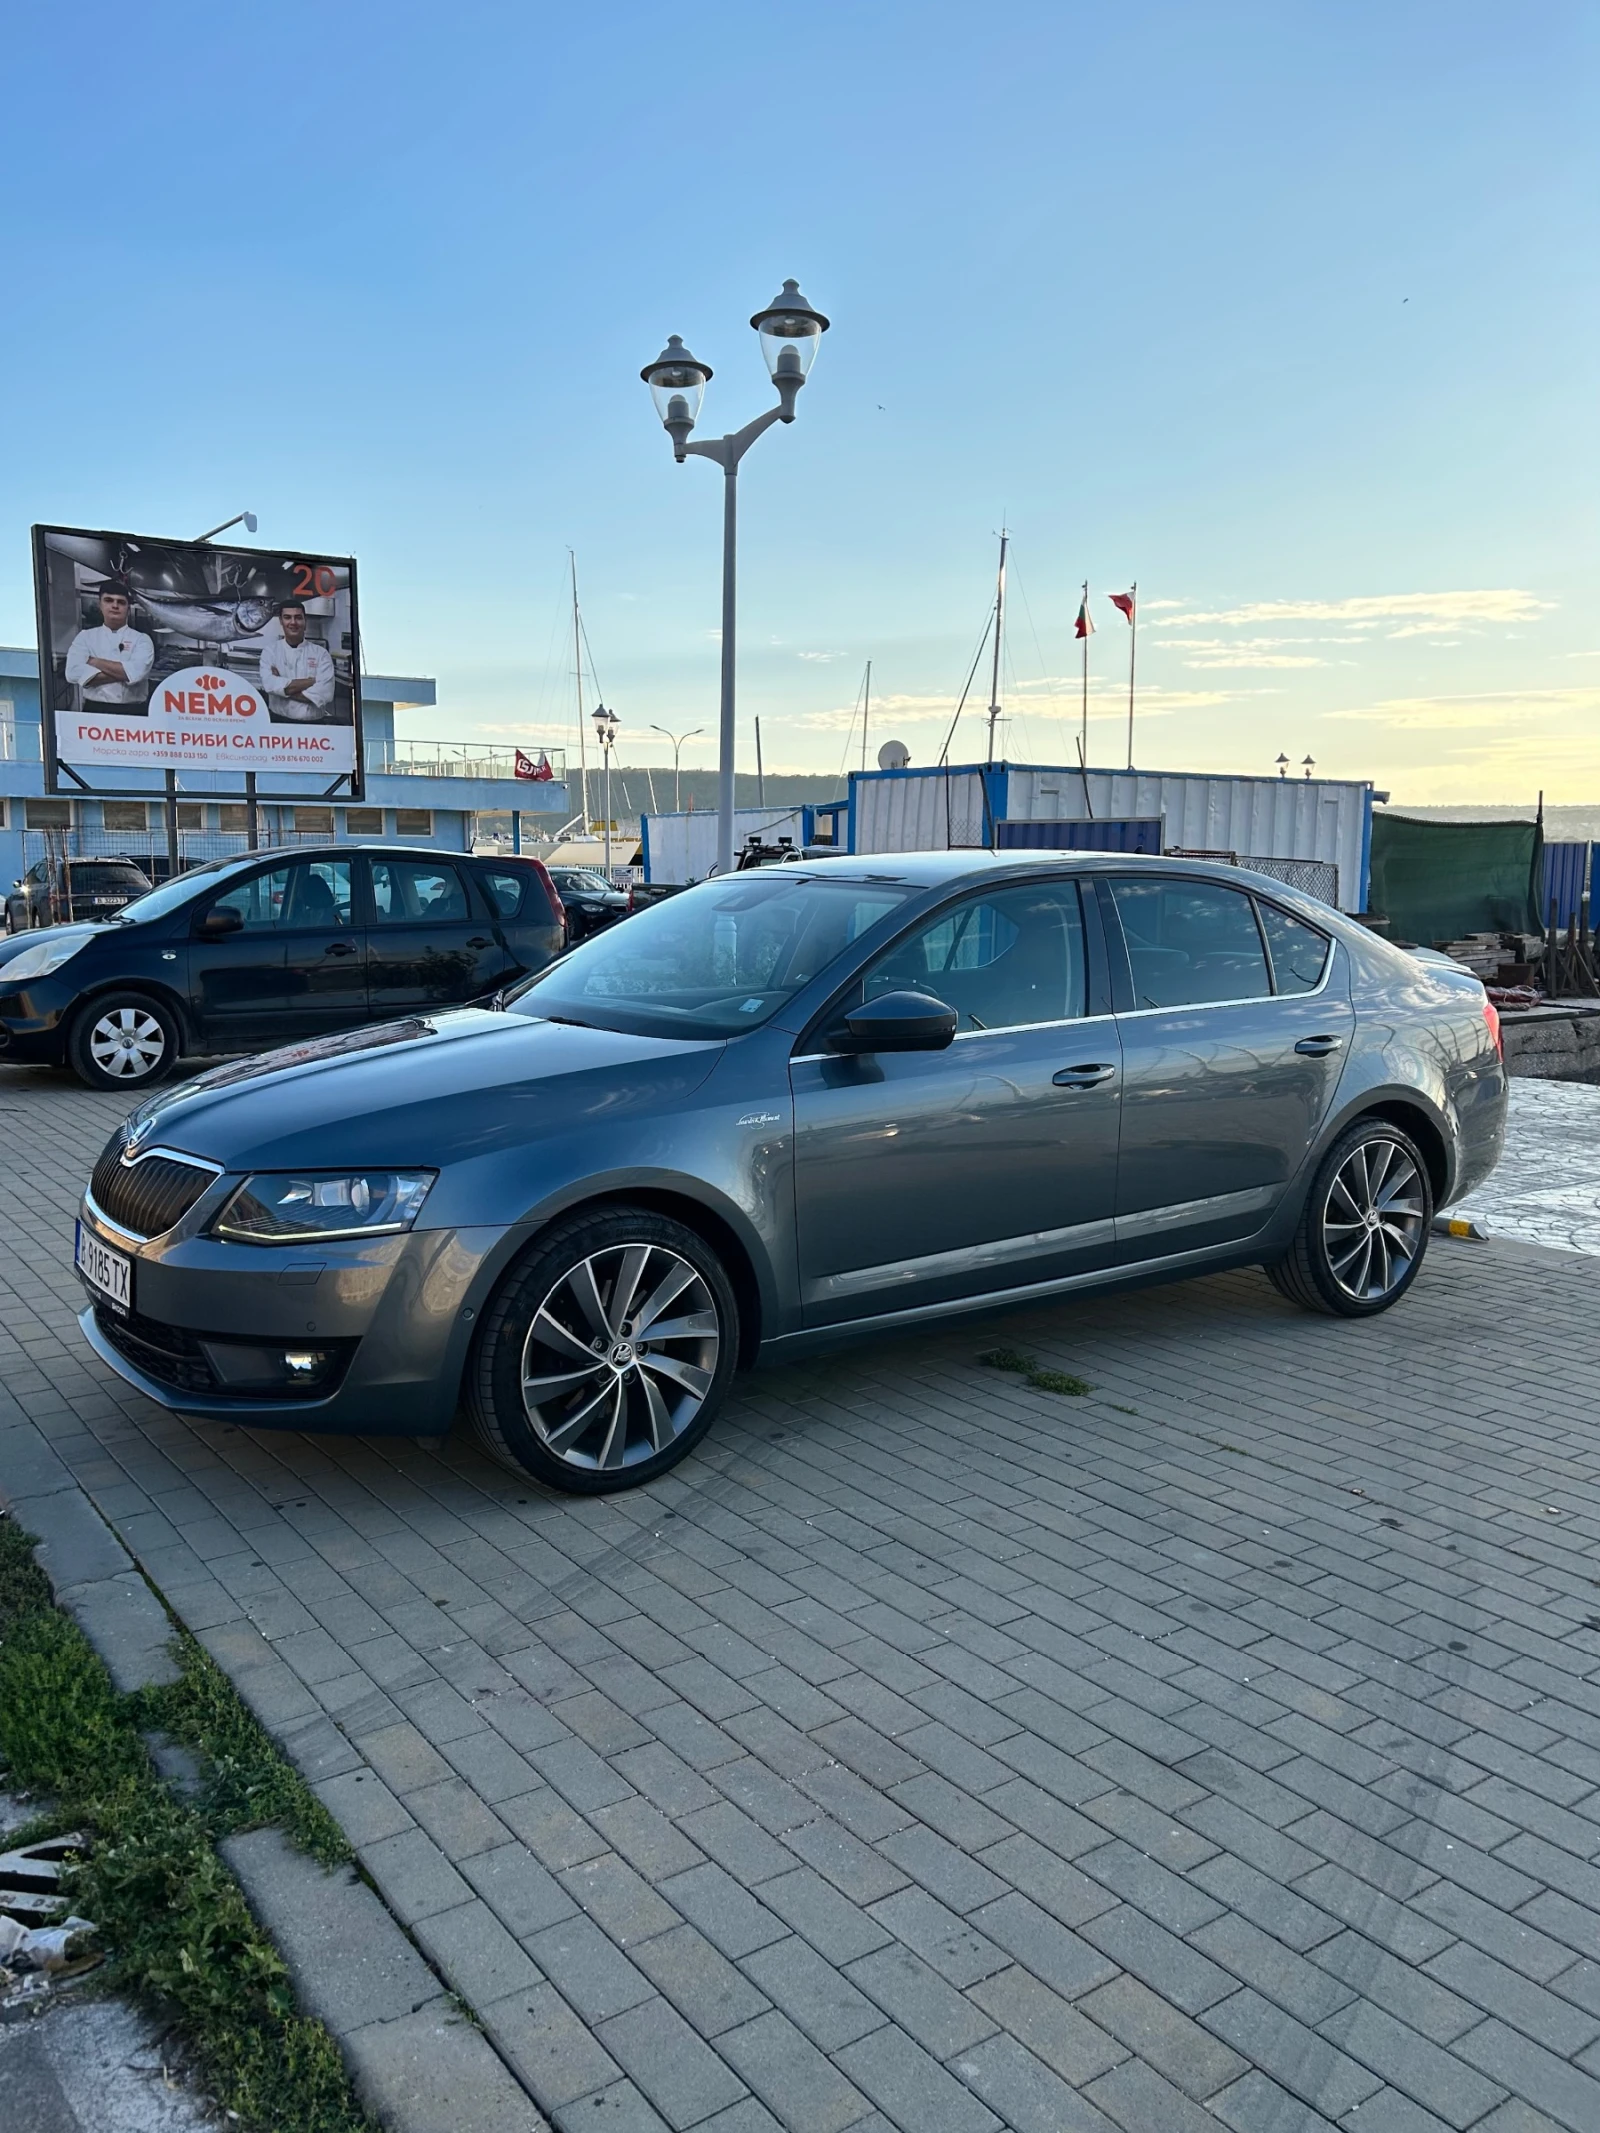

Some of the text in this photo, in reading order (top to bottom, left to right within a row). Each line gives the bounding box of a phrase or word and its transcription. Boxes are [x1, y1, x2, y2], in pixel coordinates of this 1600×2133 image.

[164, 690, 257, 717] NEMO
[78, 726, 335, 751] ГОЛЕМИТЕ РИБИ СА ПРИ НАС.
[92, 747, 127, 756] Морска
[152, 750, 168, 758] +359
[89, 1240, 110, 1287] 9185
[112, 1258, 128, 1300] TX
